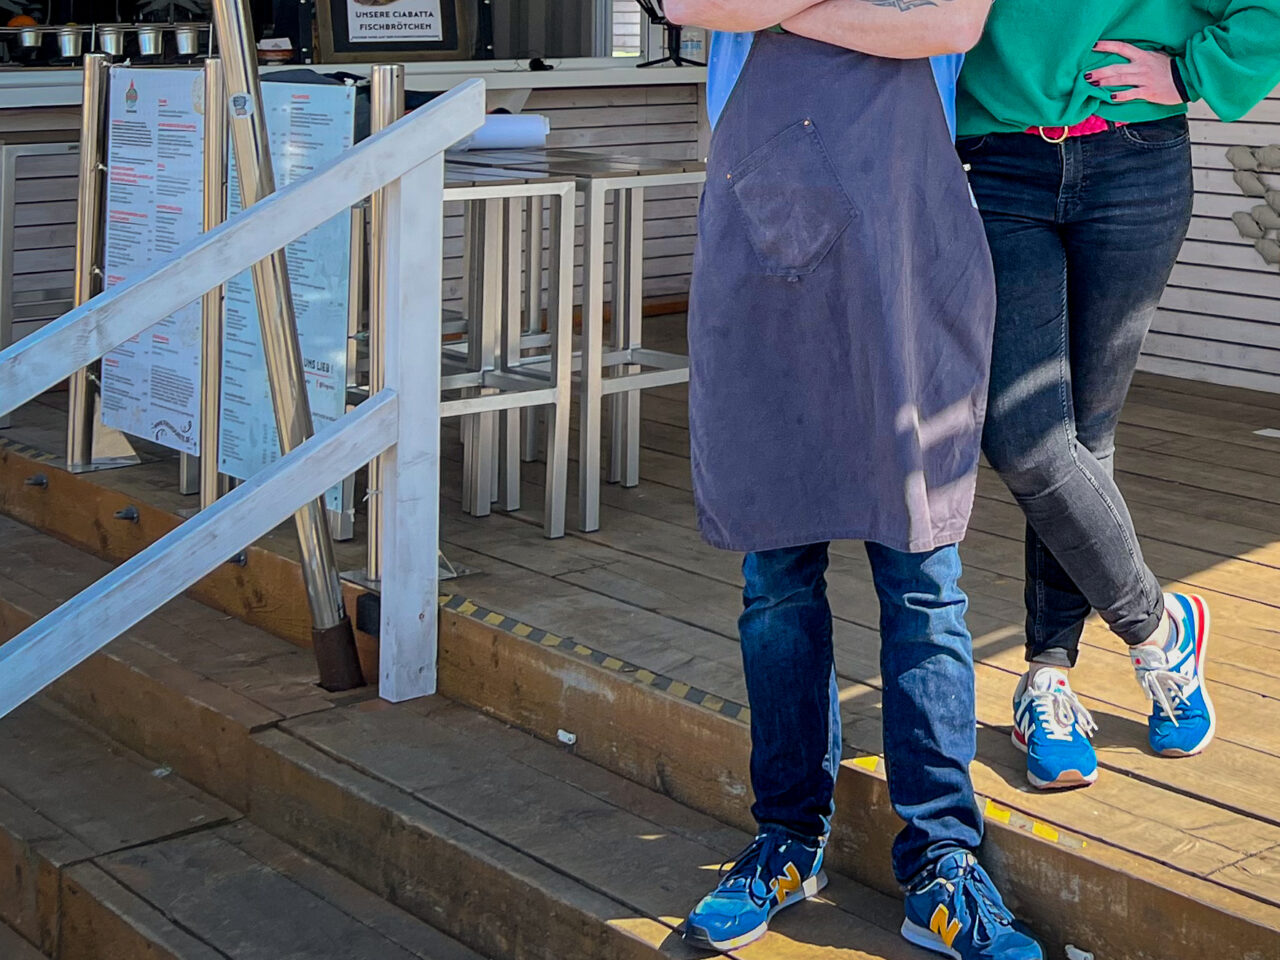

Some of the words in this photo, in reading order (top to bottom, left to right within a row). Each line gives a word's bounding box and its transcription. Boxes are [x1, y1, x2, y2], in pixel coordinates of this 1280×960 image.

[355, 10, 390, 19] UNSERE
[392, 10, 434, 18] CIABATTA
[359, 21, 432, 31] FISCHBRÖTCHEN
